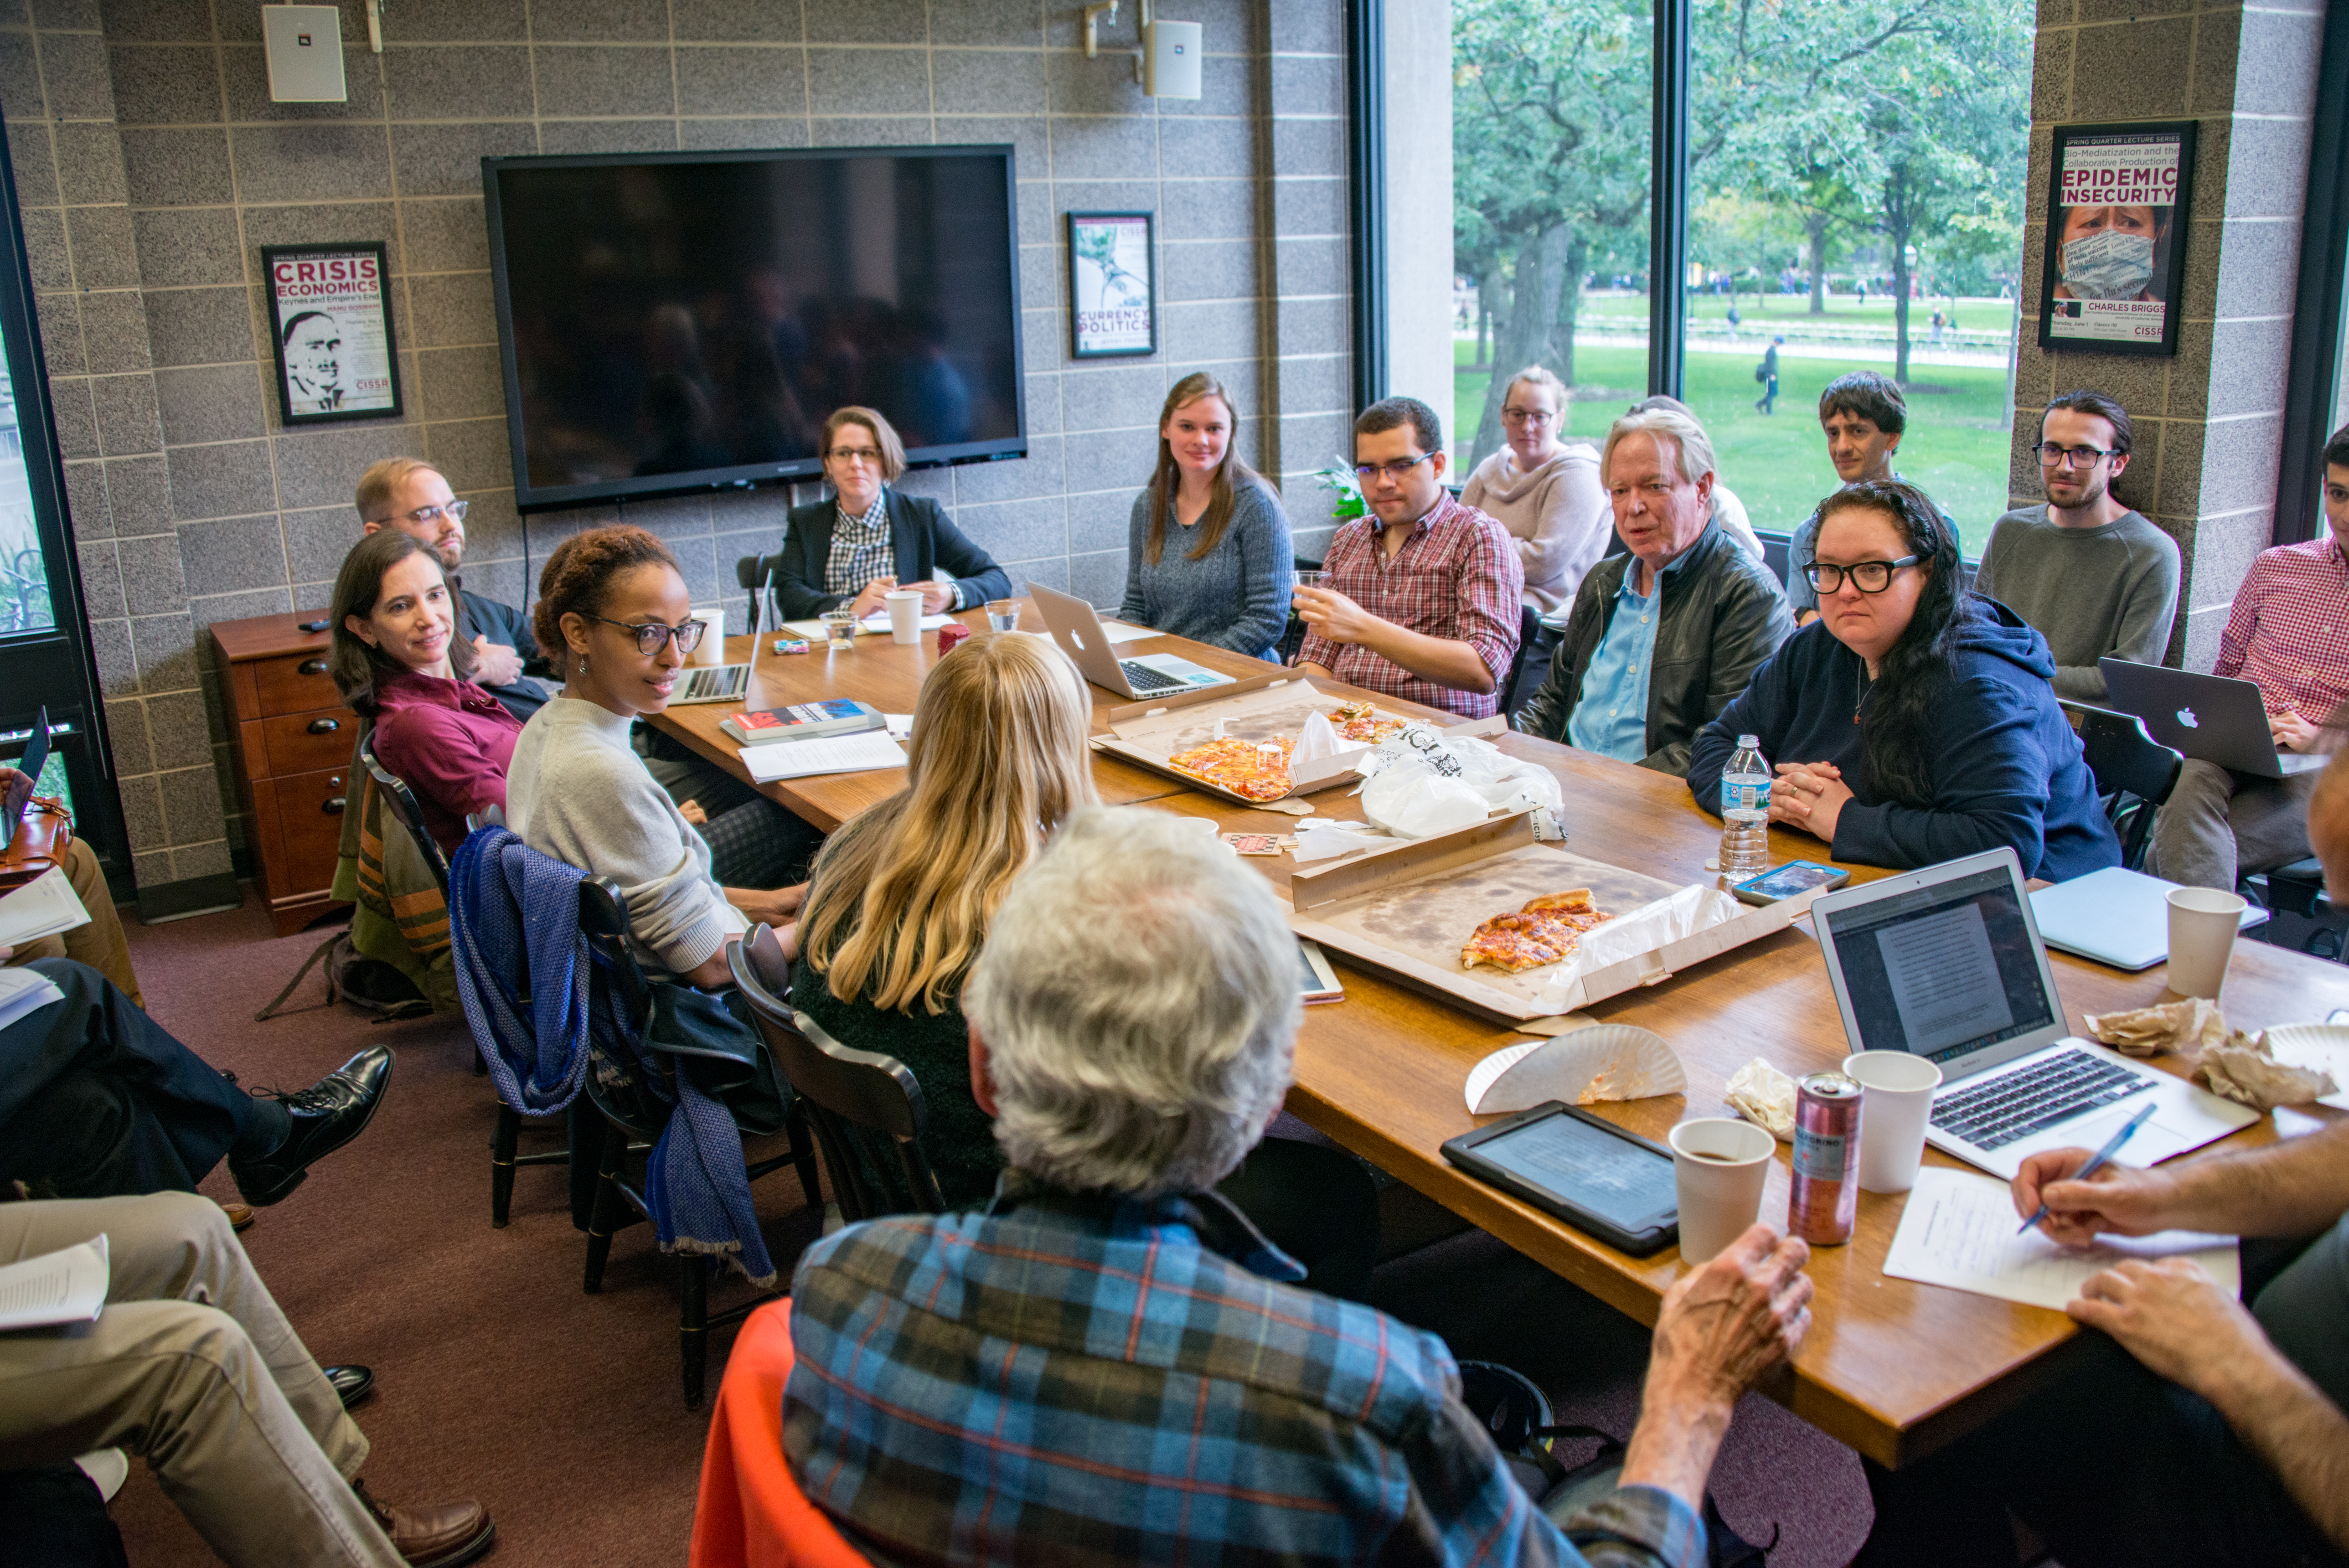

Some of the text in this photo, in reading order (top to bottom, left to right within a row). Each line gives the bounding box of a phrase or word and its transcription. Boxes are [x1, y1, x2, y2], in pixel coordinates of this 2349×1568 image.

[2064, 146, 2179, 157] Bio-Mediatization and the
[2063, 158, 2117, 167] Collaborative
[2120, 157, 2166, 166] Production
[2062, 167, 2178, 187] EPIDEMIC
[2061, 188, 2176, 203] INSECURITY
[2088, 245, 2108, 255] vaccine
[2068, 250, 2109, 270] likely sufficient
[275, 260, 377, 283] CRISIS
[2123, 272, 2152, 291] second
[277, 281, 378, 297] ECONOMICS
[327, 294, 362, 303] Empire's
[2088, 303, 2166, 313] CHARLES BRIGGS
[1078, 310, 1149, 321] CURRENCY
[1079, 320, 1150, 332] POLITICS
[2135, 327, 2163, 336] CISSR
[357, 379, 389, 389] CISSR
[1246, 837, 1259, 850] EGGS
